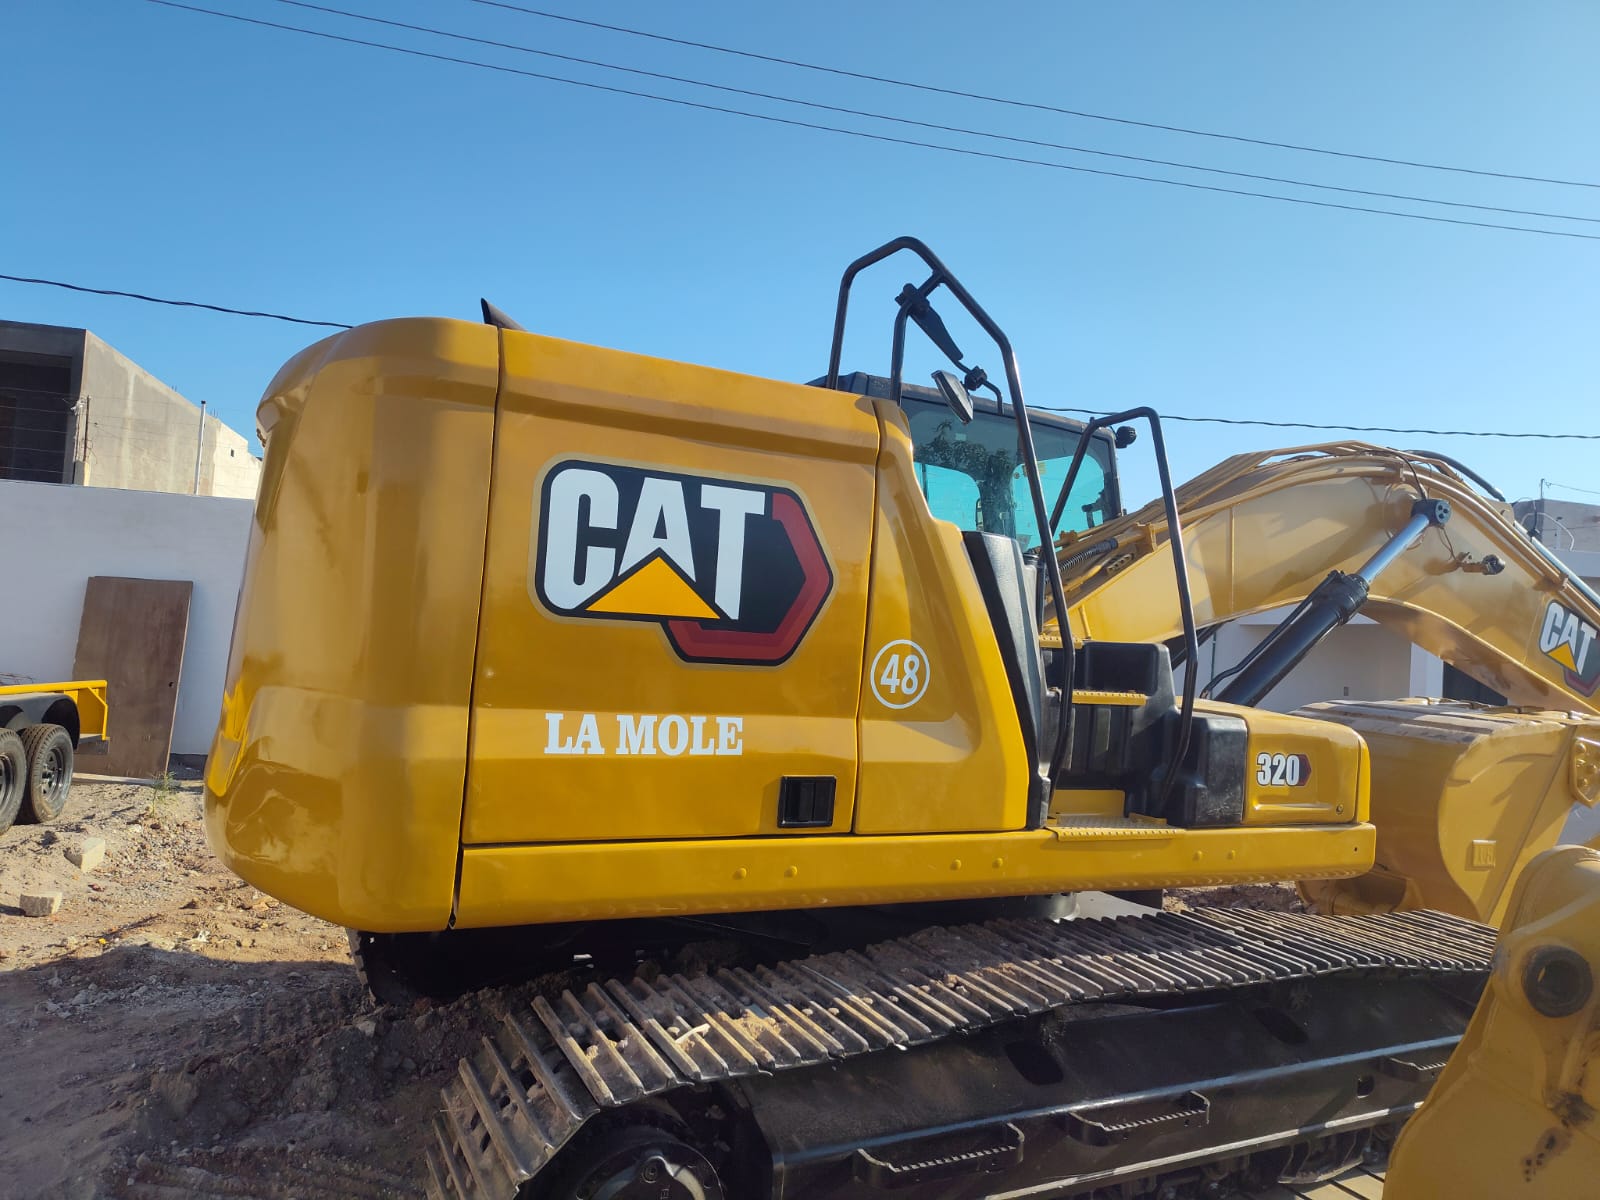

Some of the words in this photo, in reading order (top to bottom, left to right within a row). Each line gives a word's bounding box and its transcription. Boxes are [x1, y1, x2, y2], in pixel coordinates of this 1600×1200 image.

[543, 468, 766, 621] CAT
[1539, 602, 1598, 676] CAT
[880, 654, 920, 696] 48
[544, 712, 605, 756] LA
[616, 714, 744, 757] MOLE
[1257, 753, 1300, 786] 320
